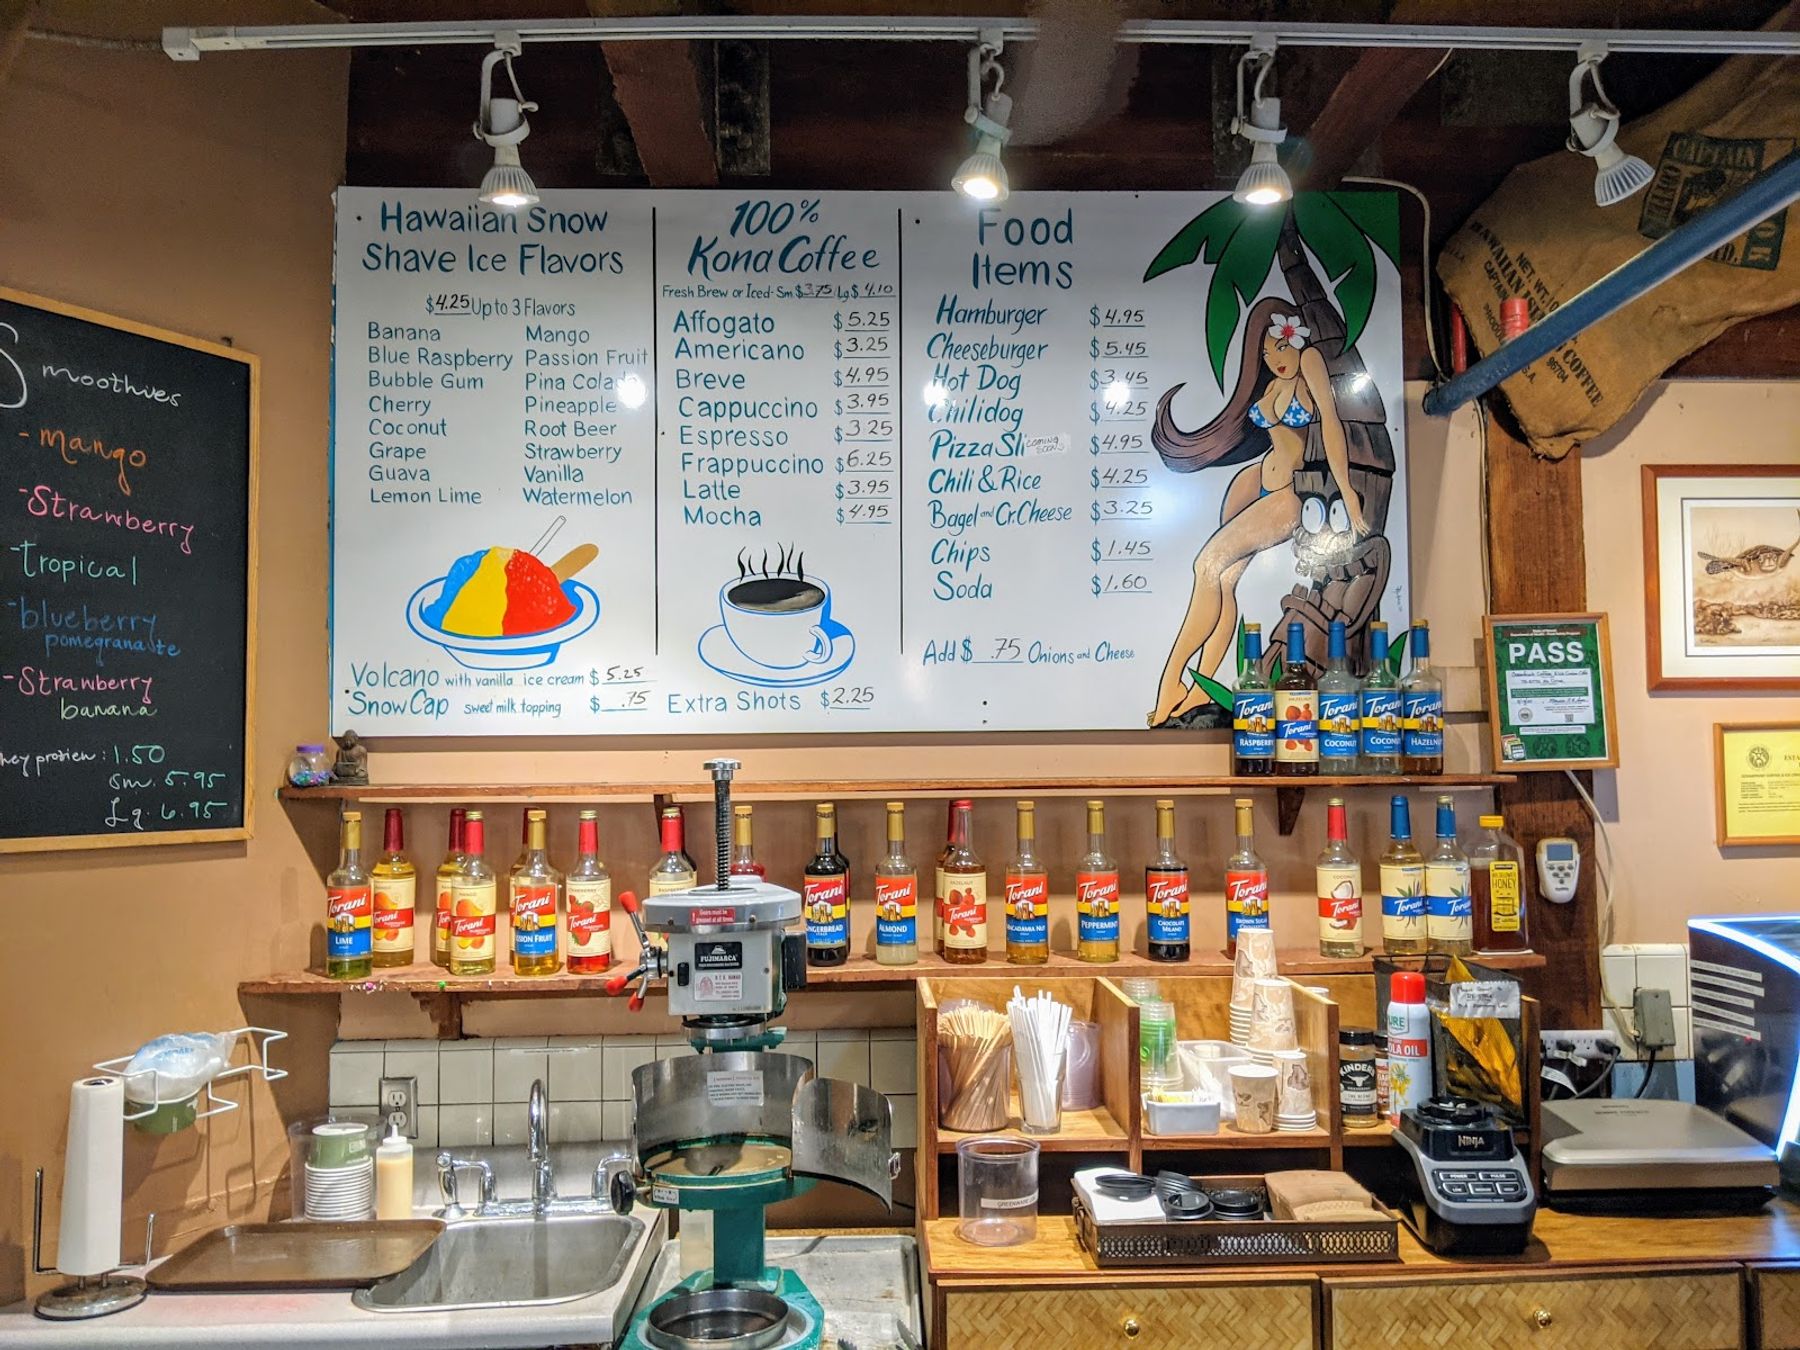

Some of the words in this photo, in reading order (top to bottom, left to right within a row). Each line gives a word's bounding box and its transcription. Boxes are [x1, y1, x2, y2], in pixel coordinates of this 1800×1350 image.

[381, 200, 518, 234] Hawaiian
[527, 206, 609, 234] Snow
[729, 199, 821, 238] 100%
[978, 208, 1074, 246] Food
[362, 243, 457, 273] Shave
[468, 243, 507, 273] Ice
[519, 243, 624, 275] Flavors
[687, 235, 774, 282] Kona
[778, 234, 881, 273] Coffee
[971, 252, 1073, 290] Items
[662, 285, 695, 298] Fresh
[697, 285, 729, 298] Brew
[732, 288, 744, 297] or
[776, 285, 794, 298] Sm
[511, 298, 521, 315] 3
[524, 298, 576, 317] Flavors
[936, 294, 1048, 335] Hamburger
[1470, 221, 1525, 294] HAWAIIAN
[1562, 348, 1604, 408] COFFEE
[368, 321, 441, 342] Banana
[526, 324, 590, 346] Mango
[673, 310, 775, 338] Affogato
[368, 346, 410, 365] Blue
[418, 347, 513, 371] Raspberry
[526, 347, 598, 365] Passion
[607, 347, 648, 365] Fruit
[675, 337, 804, 360] Americano
[926, 332, 1048, 368] Cheeseburger
[368, 370, 433, 389] Bubble
[441, 372, 484, 389] Gum
[526, 372, 565, 391] Pina
[572, 371, 640, 390] Cola
[675, 368, 746, 390] Breve
[933, 362, 970, 392] Hot
[977, 364, 1022, 400] Dog
[369, 396, 431, 416] Cherry
[526, 395, 617, 417] Pineapple
[678, 396, 818, 422] Cappuccino
[369, 418, 448, 437] Coconut
[524, 420, 567, 437] Root
[574, 421, 617, 437] Beer
[680, 425, 788, 450] Espresso
[369, 441, 427, 461] Grape
[524, 443, 622, 463] Strawberry
[929, 429, 993, 462] Pizza
[369, 465, 430, 482] Guava
[524, 464, 584, 483] Vanilla
[681, 452, 824, 477] Frappuccino
[684, 479, 741, 501] Latte
[928, 467, 975, 494] Chili
[978, 464, 998, 492] &
[999, 465, 1041, 491] Rice
[370, 488, 431, 504] Lemon
[438, 487, 482, 505] Lime
[522, 487, 632, 507] Watermelon
[684, 506, 762, 526] Mocha
[928, 500, 979, 536] Bagel
[981, 506, 994, 518] and
[931, 538, 991, 572] Chips
[933, 570, 993, 600] Soda
[923, 639, 955, 666] Add
[1028, 641, 1075, 665] Onions
[1077, 649, 1090, 659] and
[1095, 640, 1135, 662] Cheese
[1508, 641, 1585, 664] PASS
[351, 661, 439, 688] Volcano
[445, 673, 471, 687] with
[476, 672, 513, 687] vanilla
[523, 673, 543, 687] ice
[548, 674, 584, 687] cream
[60, 697, 158, 720] banana
[464, 702, 493, 715] sweet
[496, 697, 517, 714] milk
[521, 698, 561, 719] topping
[668, 693, 727, 713] Extra
[736, 690, 801, 711] Shots
[1236, 697, 1274, 720] Torani
[1320, 698, 1358, 720] Torani
[1282, 721, 1312, 738] Torani
[113, 745, 166, 764] 1.50
[805, 880, 844, 907] Torani
[876, 883, 912, 905] Torani
[1006, 881, 1043, 905] Torani
[1080, 879, 1117, 903] Torani
[1150, 879, 1188, 903] Torani
[1230, 879, 1267, 902] Torani
[1491, 879, 1517, 889] HONEY
[328, 893, 367, 918] Torani
[515, 892, 551, 915] Torani
[1331, 900, 1360, 917] Torani
[569, 913, 597, 931] Torani
[949, 906, 977, 924] Torani
[454, 918, 484, 936] Torani
[535, 934, 553, 942] FRUIT
[879, 924, 907, 933] ALMOND
[335, 935, 353, 945] LIME
[1403, 1044, 1421, 1056] OIL
[1458, 1135, 1485, 1149] NINJA
